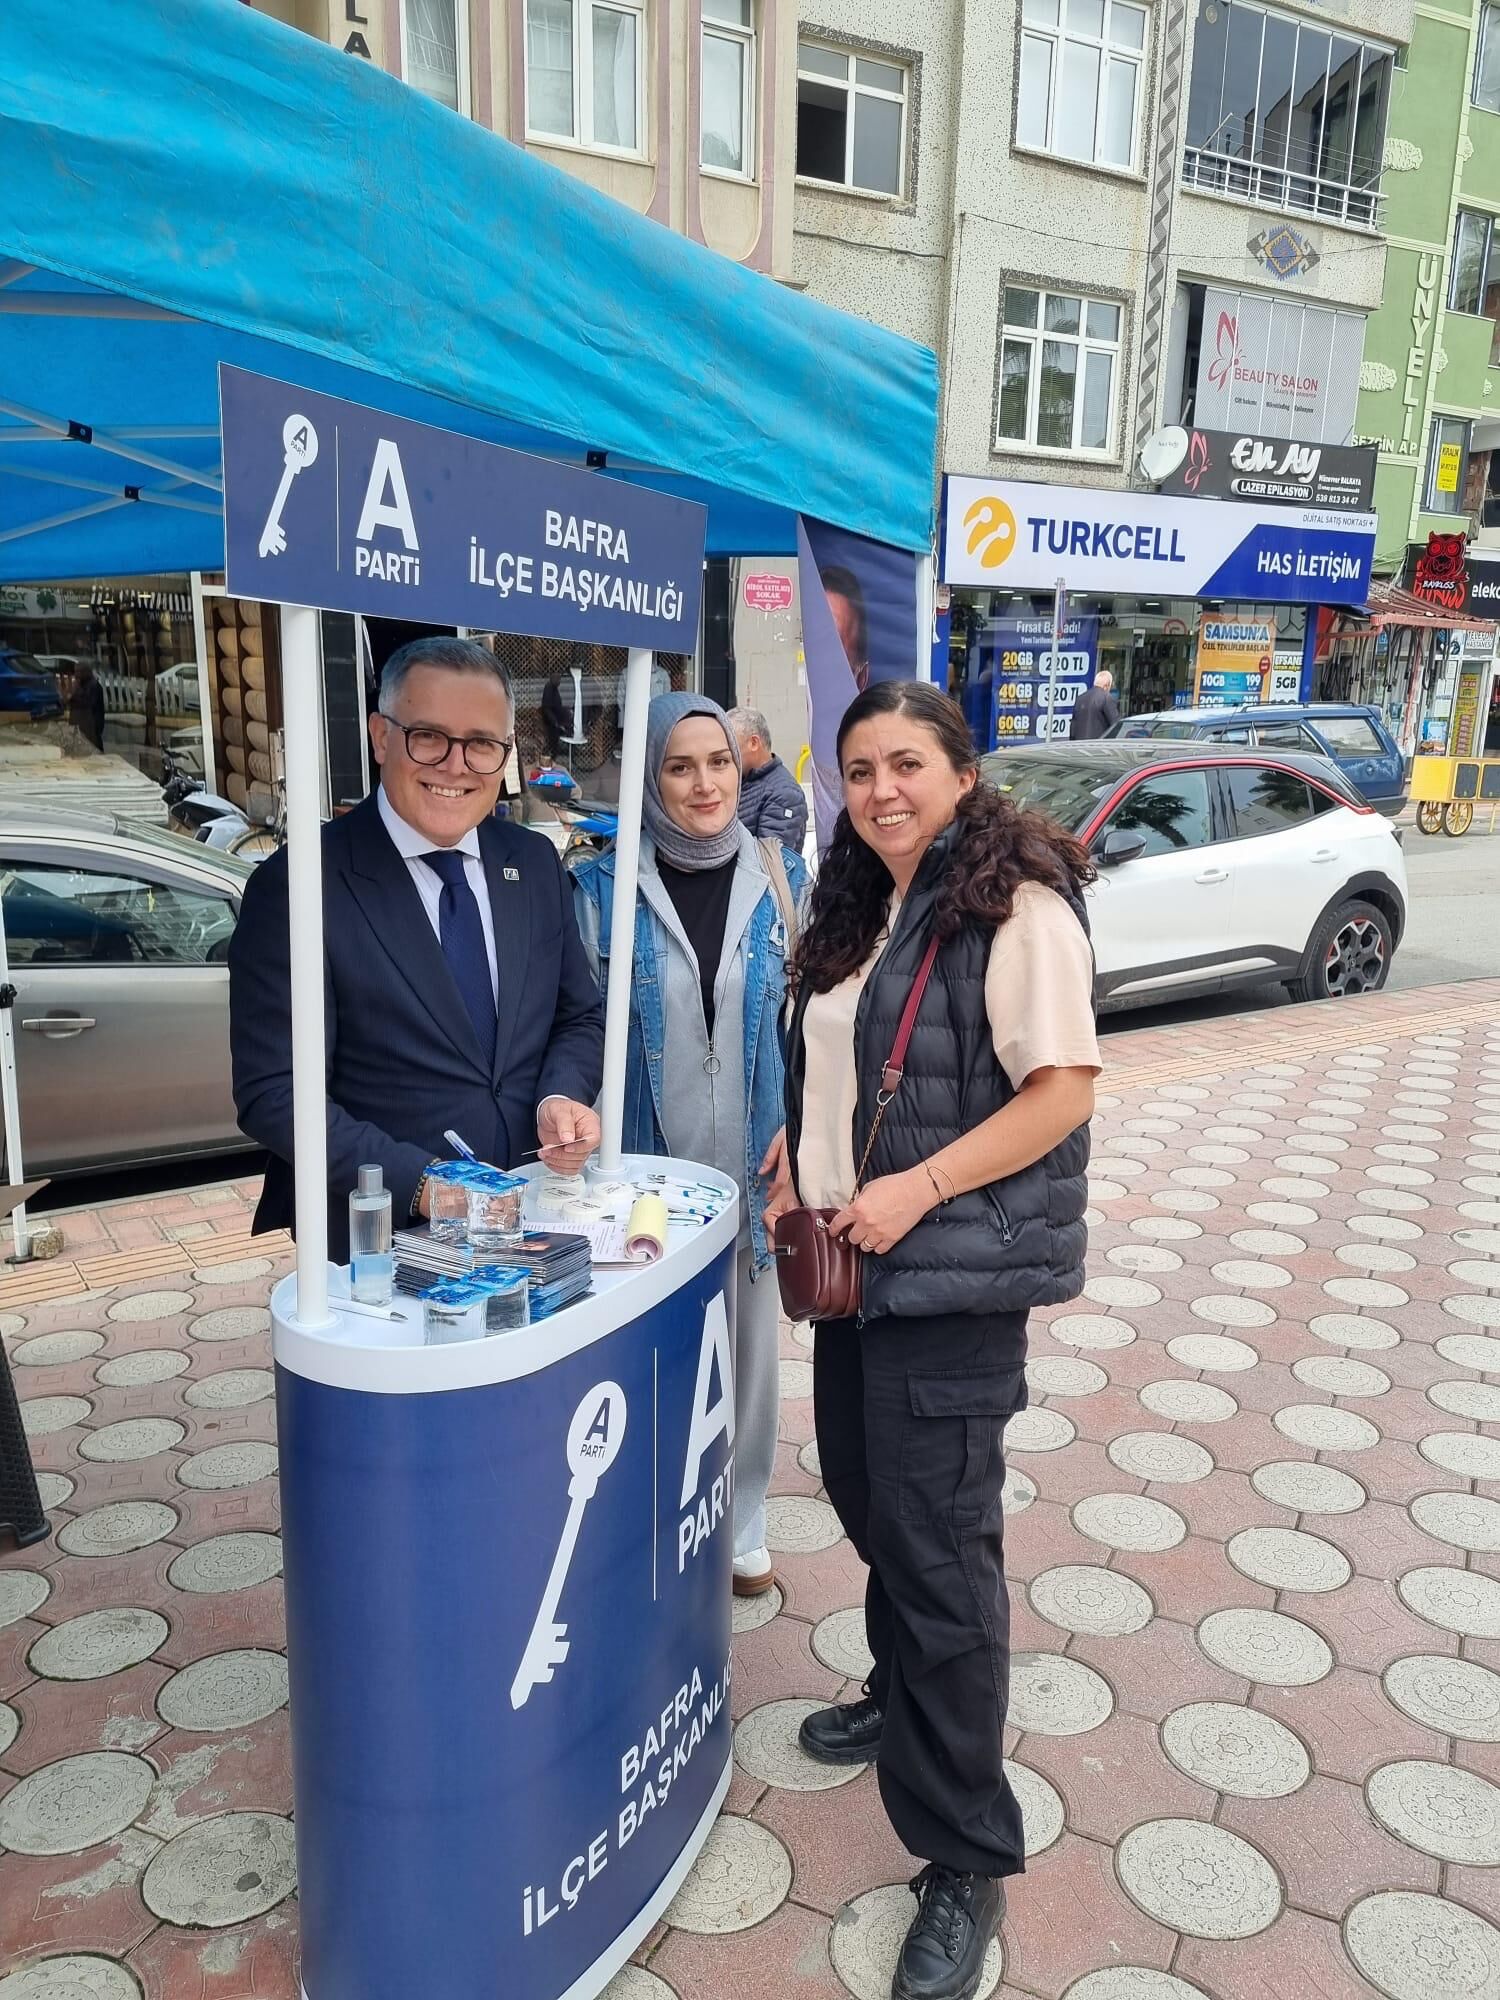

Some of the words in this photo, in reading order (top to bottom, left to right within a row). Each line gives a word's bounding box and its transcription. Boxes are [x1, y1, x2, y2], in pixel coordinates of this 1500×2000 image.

[1234, 367, 1279, 386] BEAUTY
[1281, 374, 1319, 392] SALON
[293, 425, 308, 451] A
[355, 438, 420, 551] A
[1241, 479, 1266, 495] LAZER
[1267, 481, 1309, 500] EPİLASYON
[545, 509, 630, 564] BAFRA
[1027, 517, 1186, 563] TURKCELL
[469, 536, 533, 598] İLÇE
[541, 561, 683, 622] BAŞKANLIĞI
[1257, 550, 1292, 576] HAS
[1295, 548, 1361, 584] İLETİŞİM
[1043, 621, 1081, 634] Baadı!
[1002, 651, 1034, 667] 20GB
[998, 683, 1033, 698] 40GB
[1201, 674, 1225, 687] 10GB
[1245, 674, 1261, 687] 199
[1275, 676, 1297, 689] 5GB
[998, 715, 1030, 730] 60GB
[679, 1289, 736, 1511] A
[584, 1397, 611, 1443] A
[678, 1448, 735, 1575] PART
[621, 1666, 703, 1794] BAFRA
[523, 1828, 608, 1937] İLÇE
